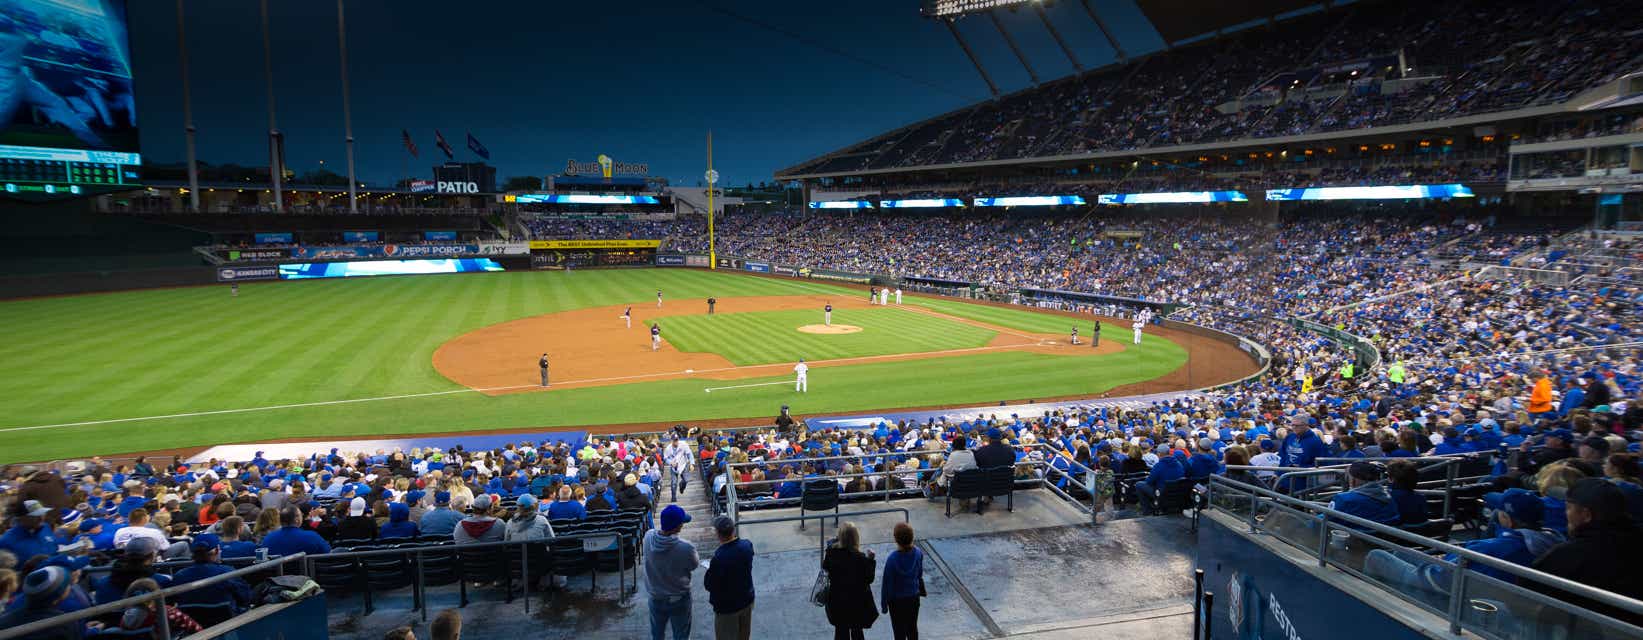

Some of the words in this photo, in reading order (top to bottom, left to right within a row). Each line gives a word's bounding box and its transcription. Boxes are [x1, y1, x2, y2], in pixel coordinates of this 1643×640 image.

[615, 161, 648, 175] MOON
[437, 181, 478, 193] PATIO
[403, 246, 429, 254] PEPSI
[432, 245, 466, 254] PORCH
[1269, 591, 1302, 640] RESTR
